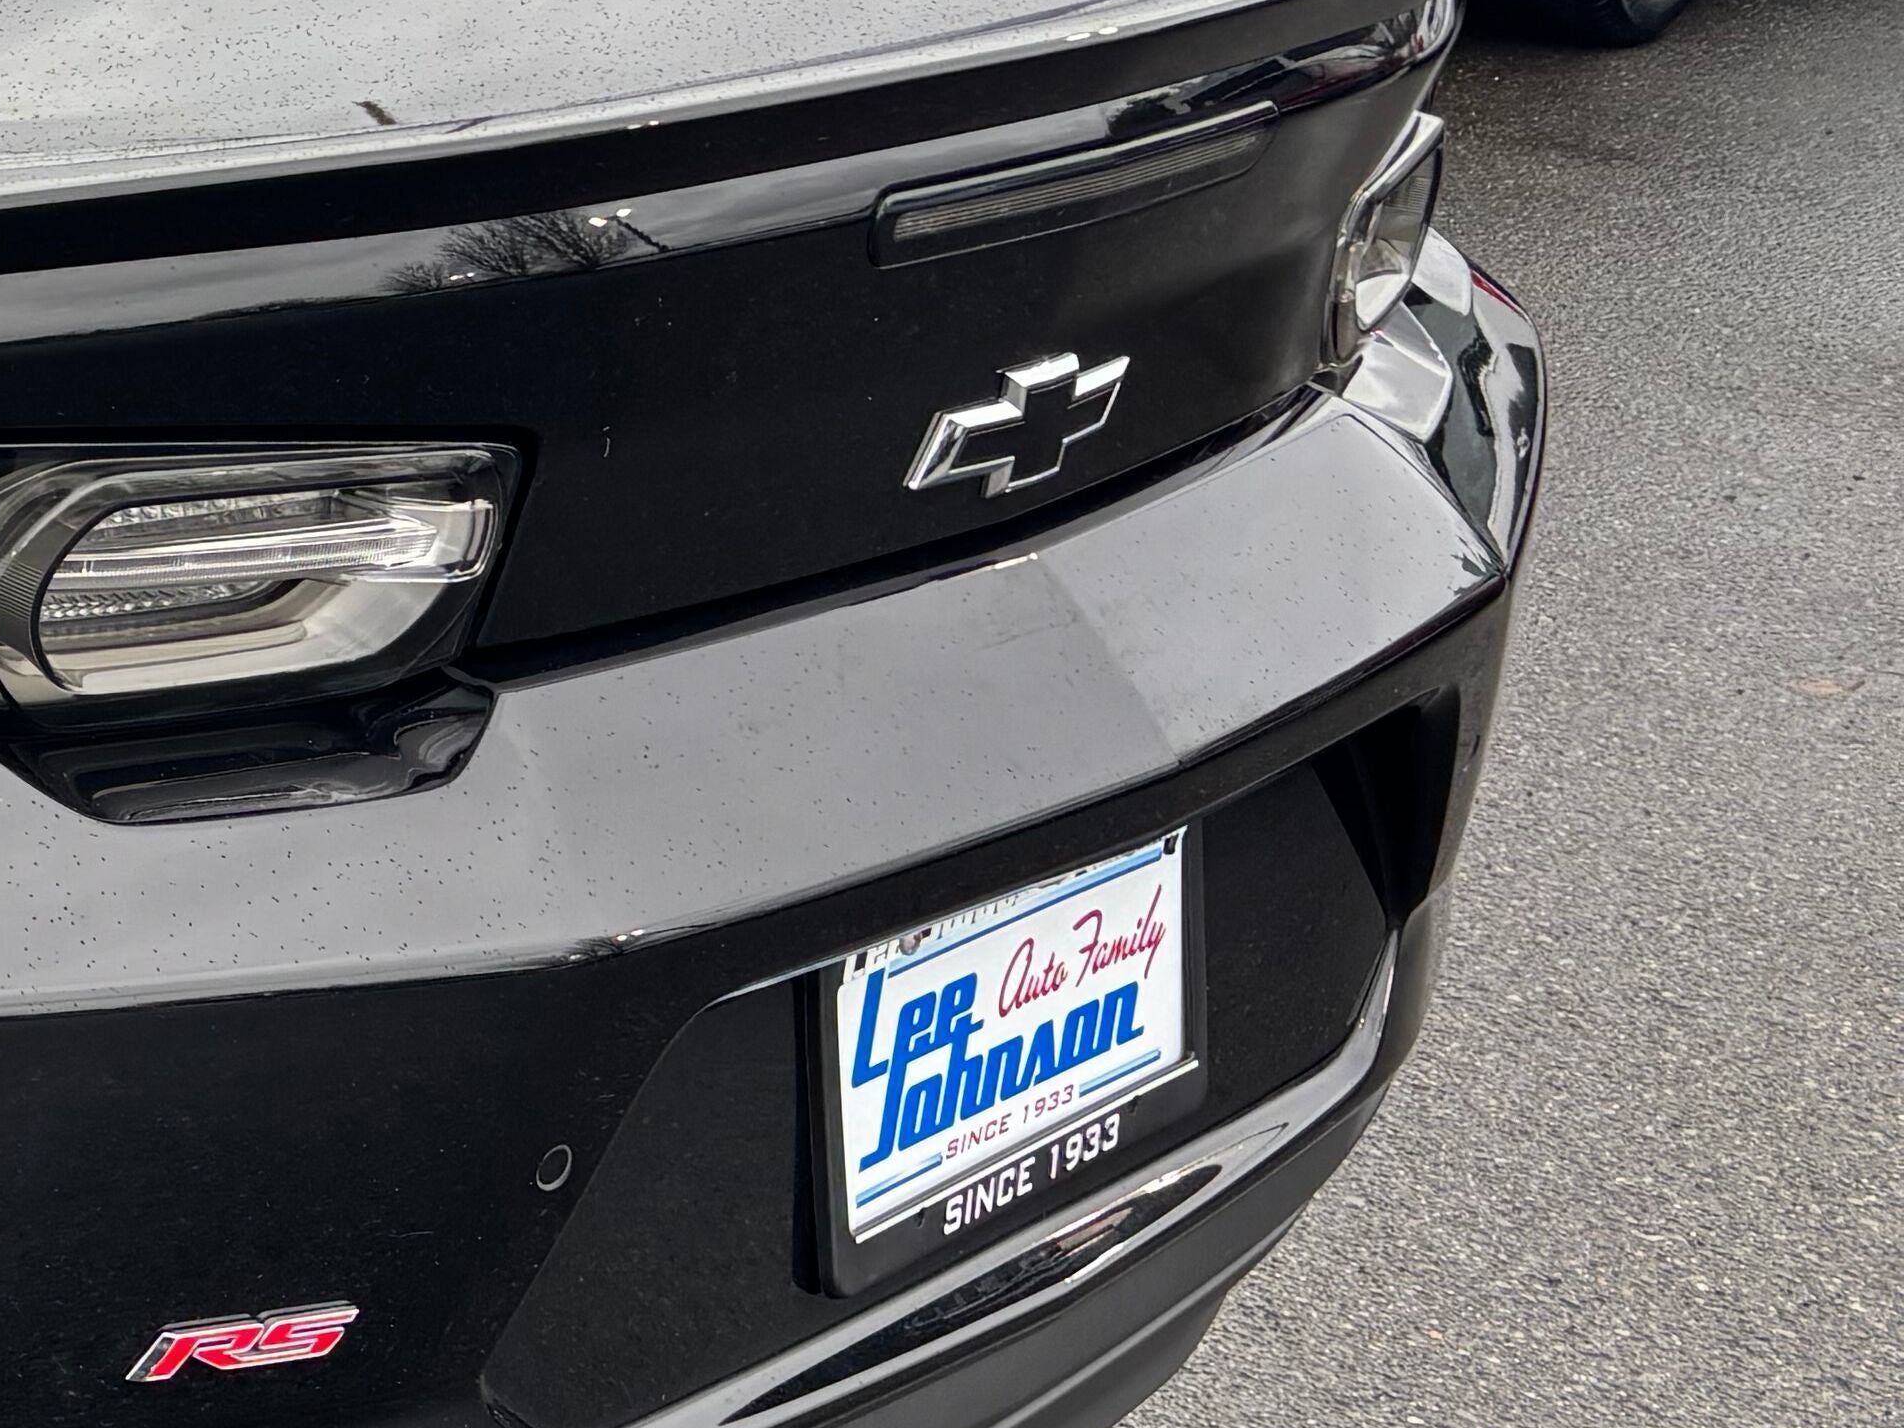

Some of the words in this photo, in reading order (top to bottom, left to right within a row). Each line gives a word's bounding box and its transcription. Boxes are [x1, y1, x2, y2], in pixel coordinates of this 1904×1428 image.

[999, 937, 1068, 1018] Auto
[1072, 884, 1166, 988] Family
[852, 968, 978, 1088] Lee
[859, 981, 1144, 1173] Johnson
[943, 1156, 1036, 1235] SINCE
[1050, 1113, 1120, 1179] 1933
[945, 1112, 1012, 1160] SINCE
[1023, 1084, 1074, 1124] 1933
[126, 1303, 359, 1382] RS
